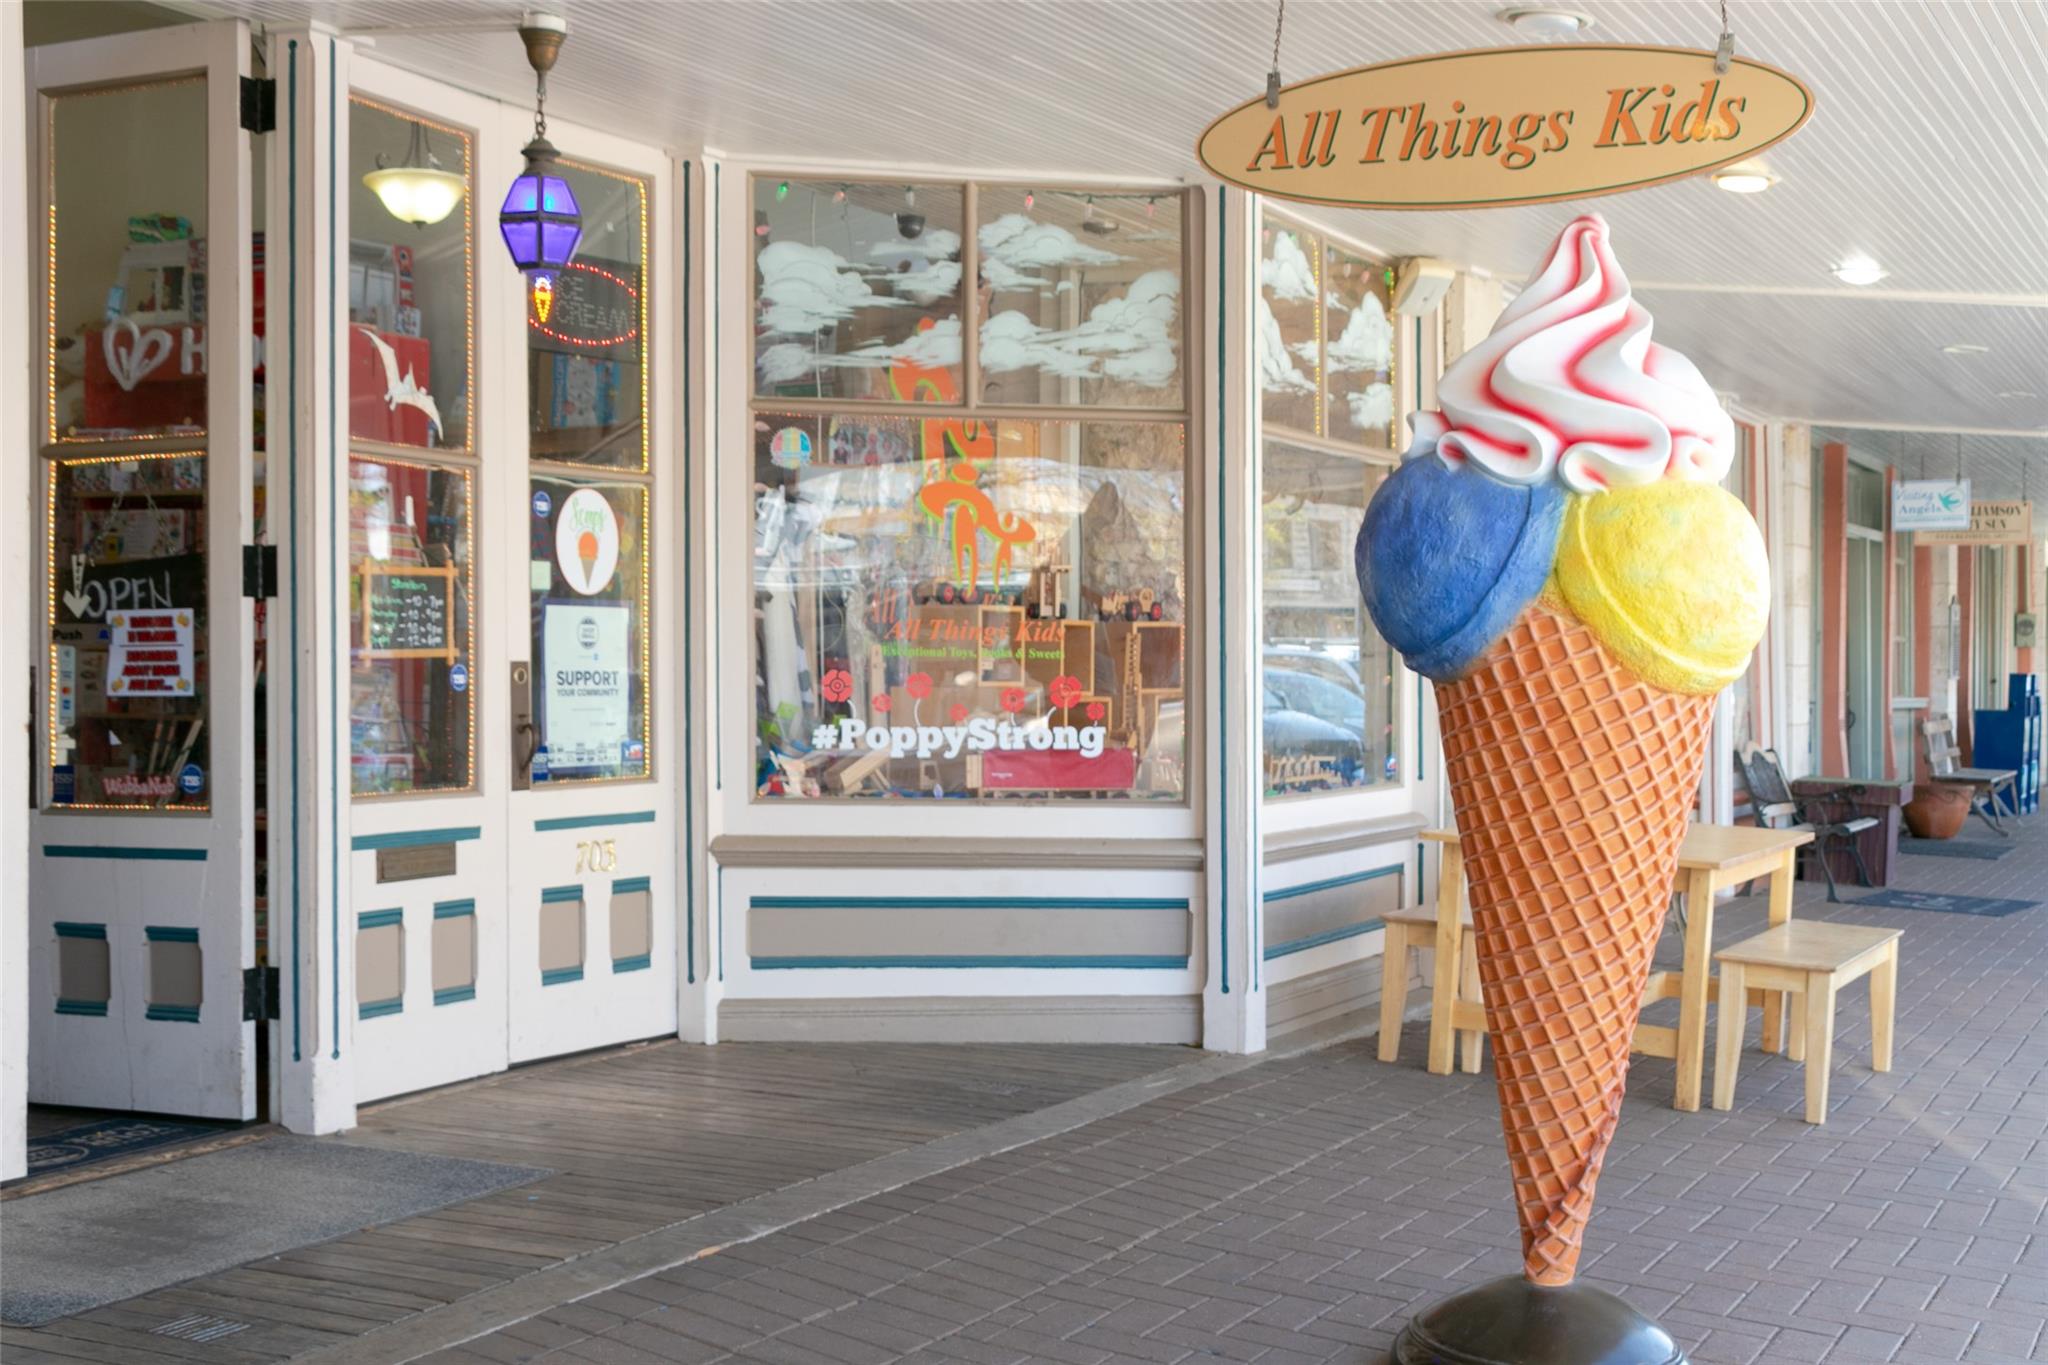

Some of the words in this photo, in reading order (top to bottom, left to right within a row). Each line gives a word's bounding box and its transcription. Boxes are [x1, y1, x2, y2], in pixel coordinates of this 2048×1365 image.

[1246, 107, 1342, 172] All
[1358, 100, 1574, 170] Things
[1593, 80, 1747, 149] Kids
[52, 629, 83, 643] Push
[884, 617, 921, 641] All
[928, 619, 1008, 646] Things
[1014, 620, 1066, 643] Kids
[556, 670, 619, 686] SUPPORT
[557, 688, 575, 697] YOUR
[577, 688, 619, 697] COMMUNITY
[812, 717, 1106, 759] #PoppyStrong
[575, 838, 617, 875] 705
